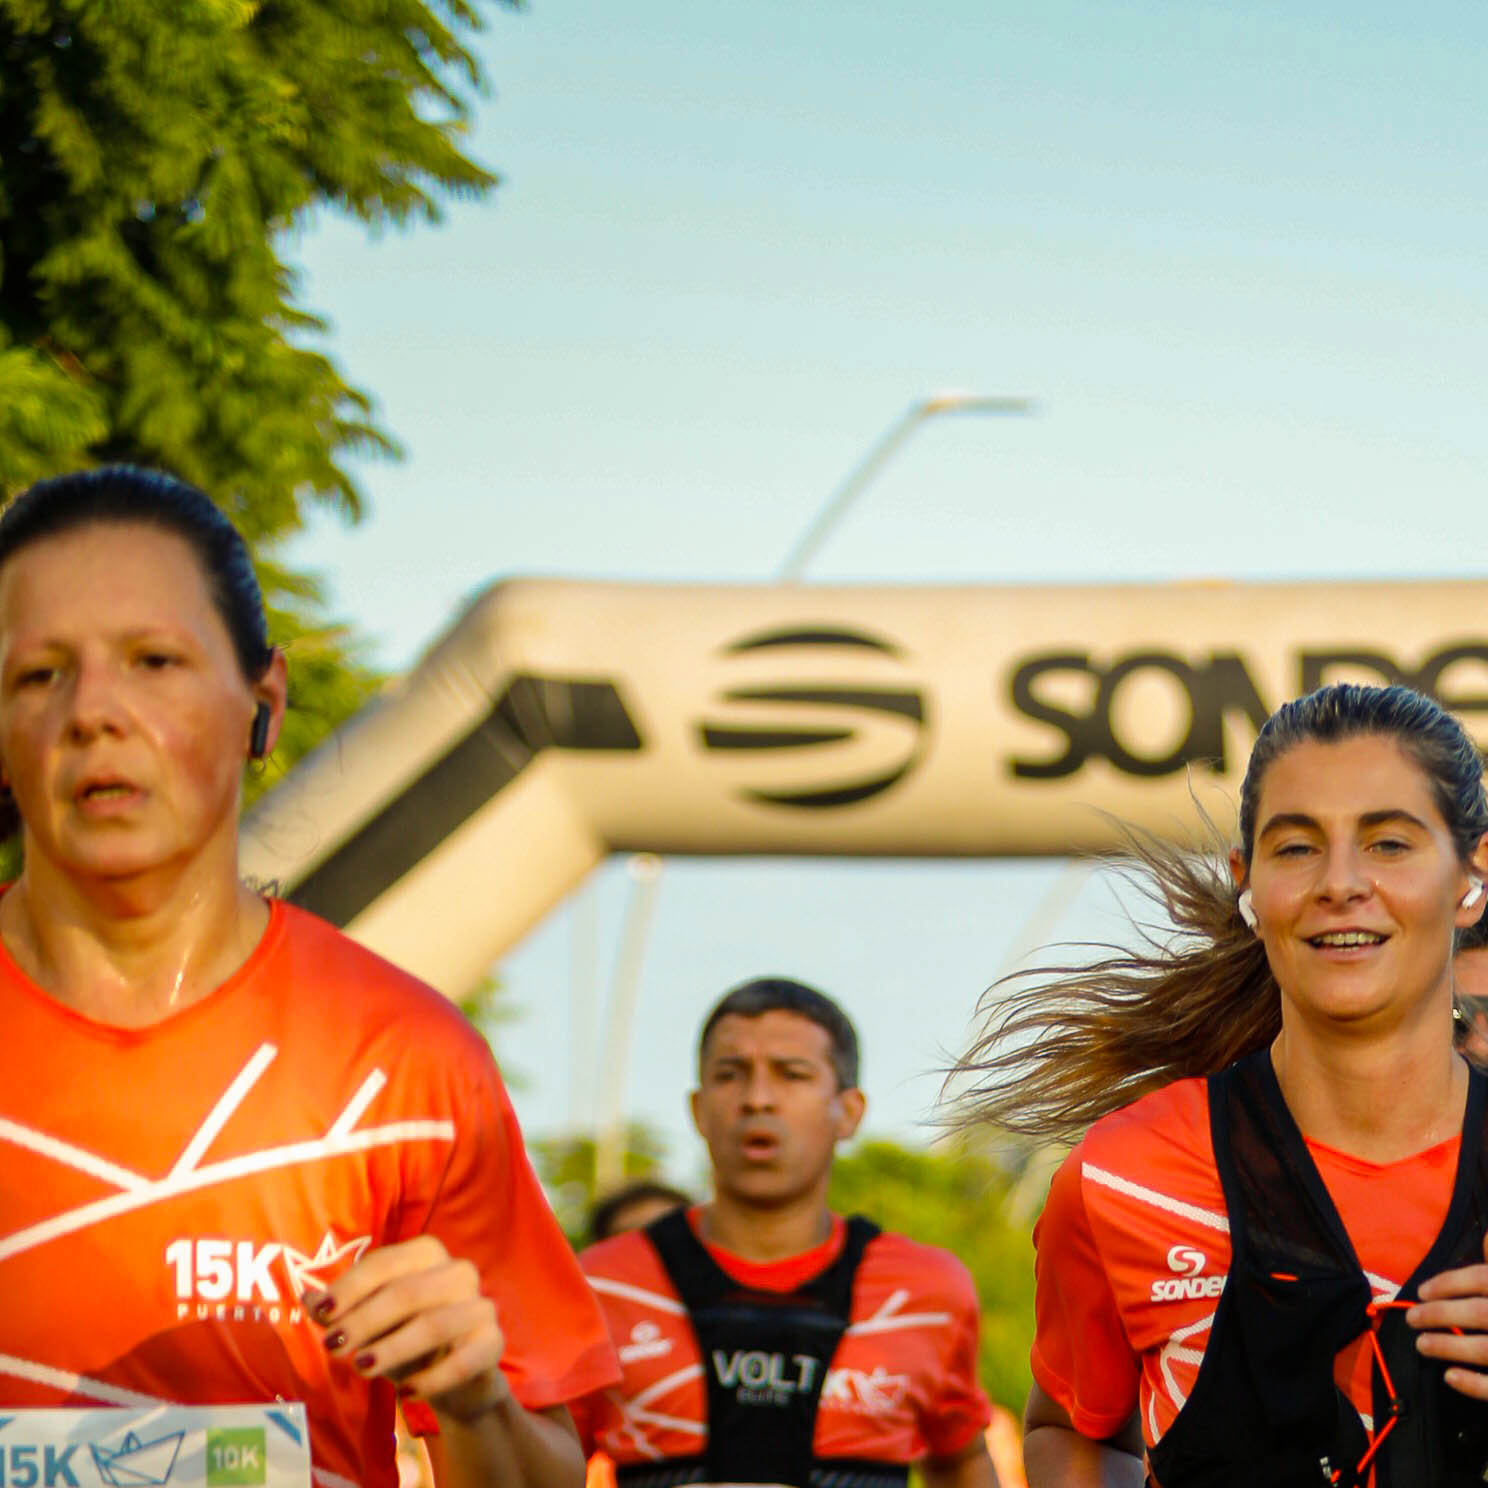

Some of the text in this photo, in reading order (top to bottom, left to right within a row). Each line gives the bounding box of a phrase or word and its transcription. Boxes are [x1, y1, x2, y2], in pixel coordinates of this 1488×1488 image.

[165, 1239, 283, 1301] 15K
[712, 1350, 820, 1394] VOLT
[213, 1445, 259, 1471] 10K
